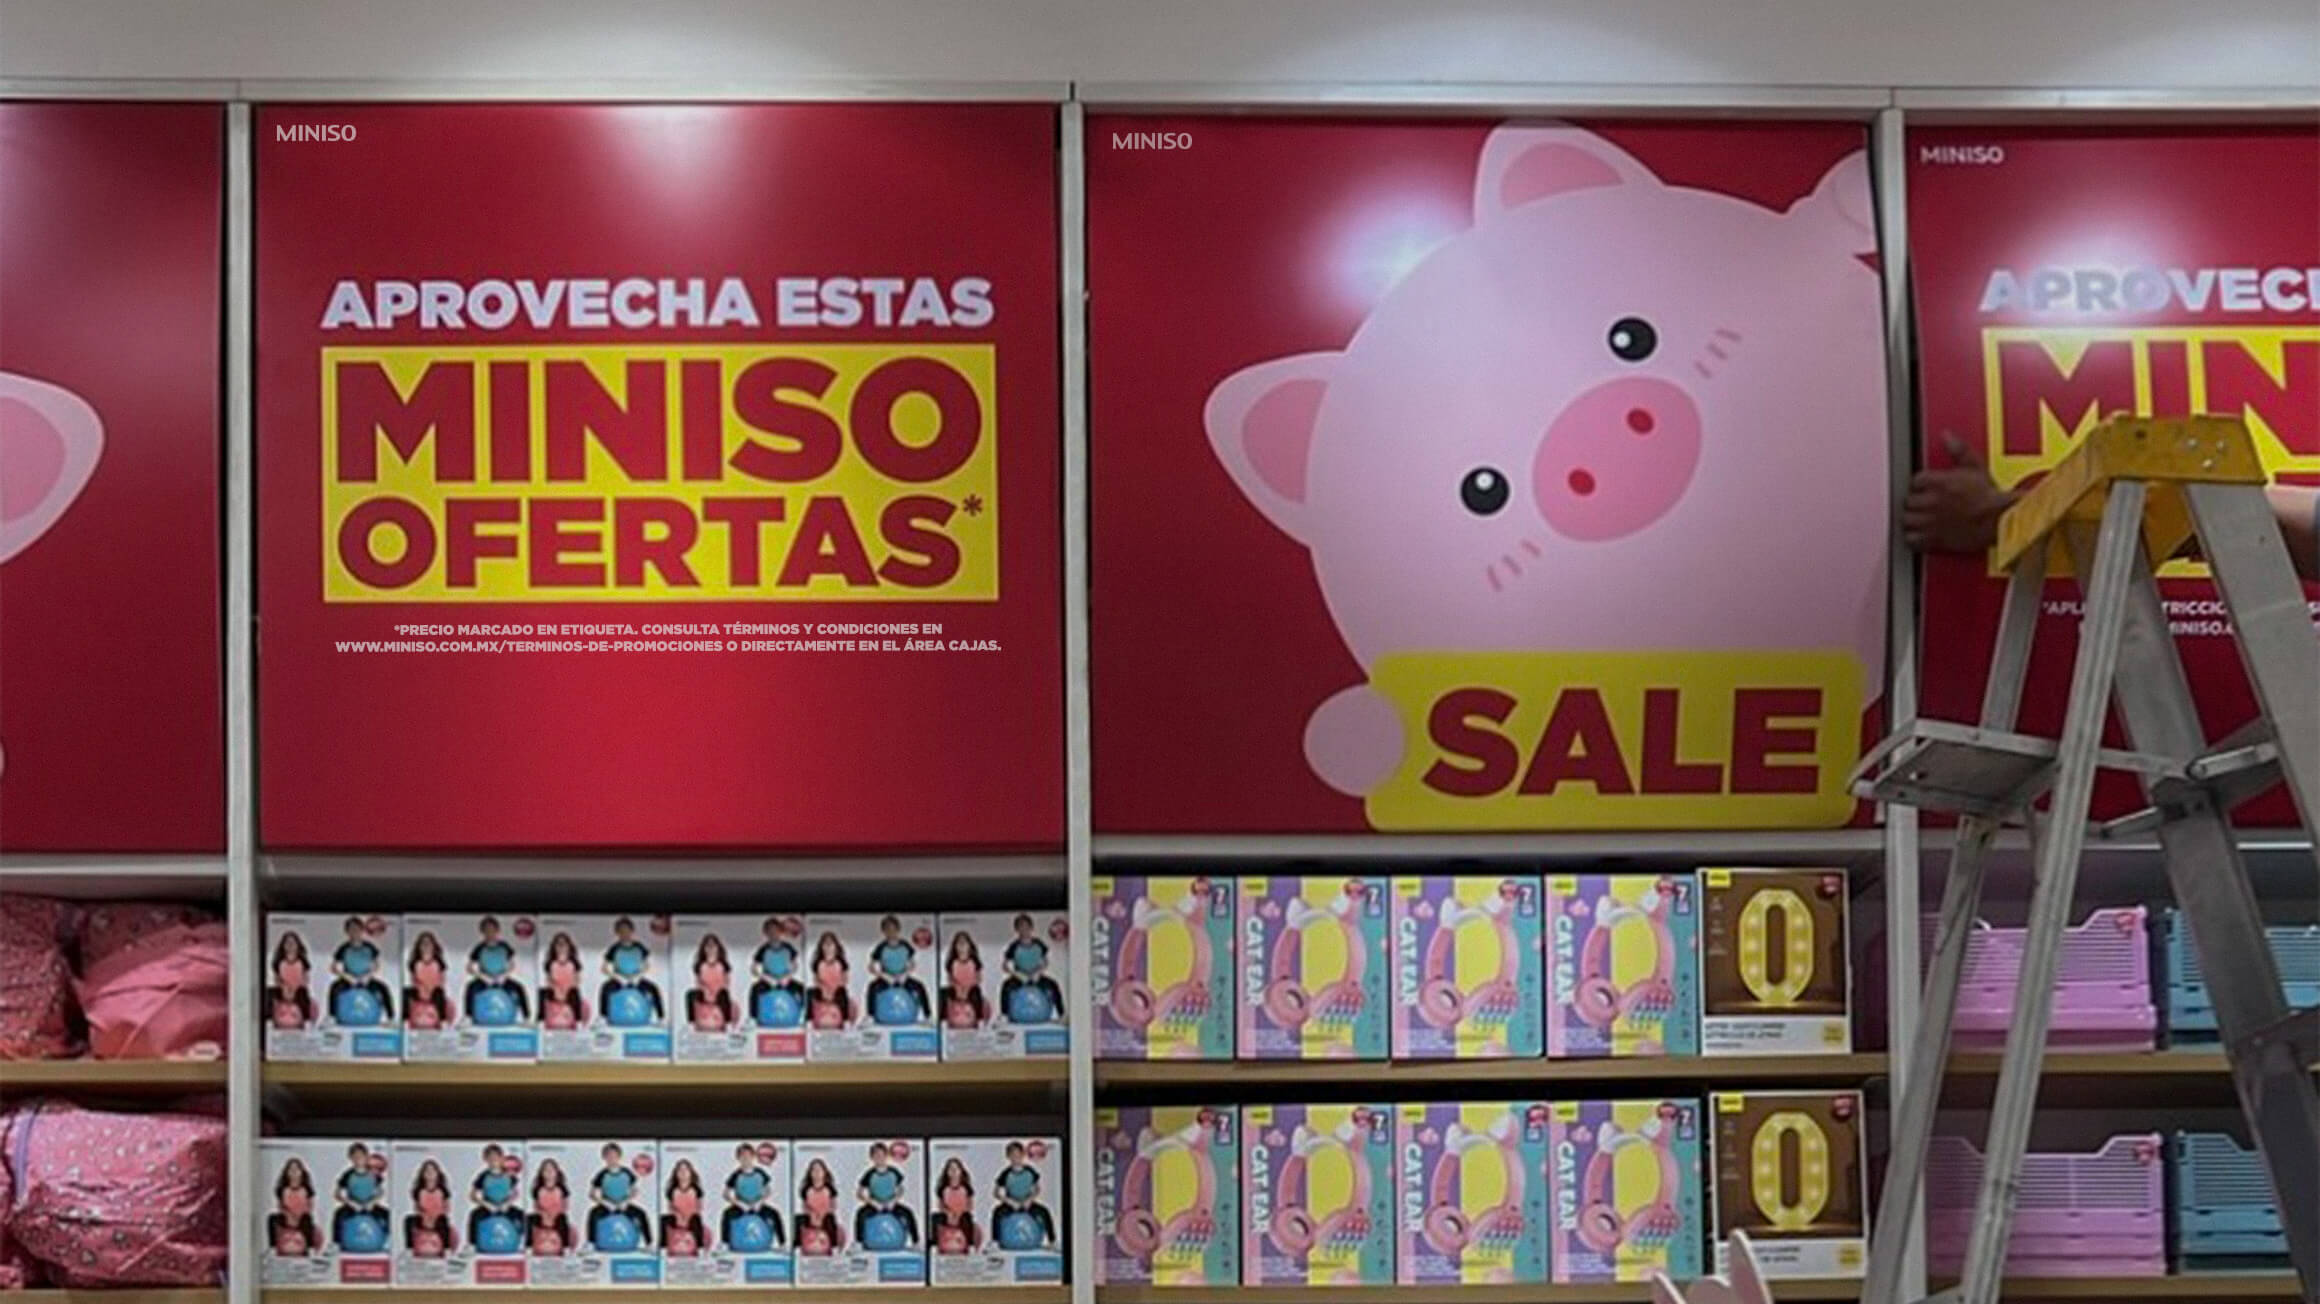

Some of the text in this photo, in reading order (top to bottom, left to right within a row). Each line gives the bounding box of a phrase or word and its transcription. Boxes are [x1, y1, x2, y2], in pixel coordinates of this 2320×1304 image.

[276, 124, 357, 142] MINISO
[1112, 132, 1193, 150] MINISO
[1920, 146, 2005, 164] MINISO
[321, 277, 994, 330] APROVECHA ESTAS
[336, 355, 983, 484] MINISO
[1997, 340, 2320, 457] MIN
[458, 624, 534, 636] MARCADO
[537, 624, 557, 636] EN
[561, 623, 638, 636] ETIQUETA.
[641, 623, 720, 636] CONSULTA
[723, 620, 800, 635] TÉRMINOS
[802, 623, 813, 635] Y
[817, 623, 919, 635] CONDICIONES
[922, 623, 943, 635] EN
[726, 640, 738, 652] O
[741, 640, 856, 652] DIRECTAMENTE
[859, 640, 879, 652] EN
[882, 640, 900, 652] EL
[904, 637, 945, 652] ÁREA
[948, 639, 1002, 652] CAJAS.
[1421, 686, 1824, 799] SALE
[1247, 917, 1264, 960] CAT
[1400, 917, 1417, 960] CAT
[1555, 915, 1573, 958] CAT
[1097, 1148, 1115, 1189] CAT
[1252, 1145, 1269, 1189] CAT
[1405, 1143, 1422, 1187] CAT
[1557, 1142, 1575, 1185] CAT
